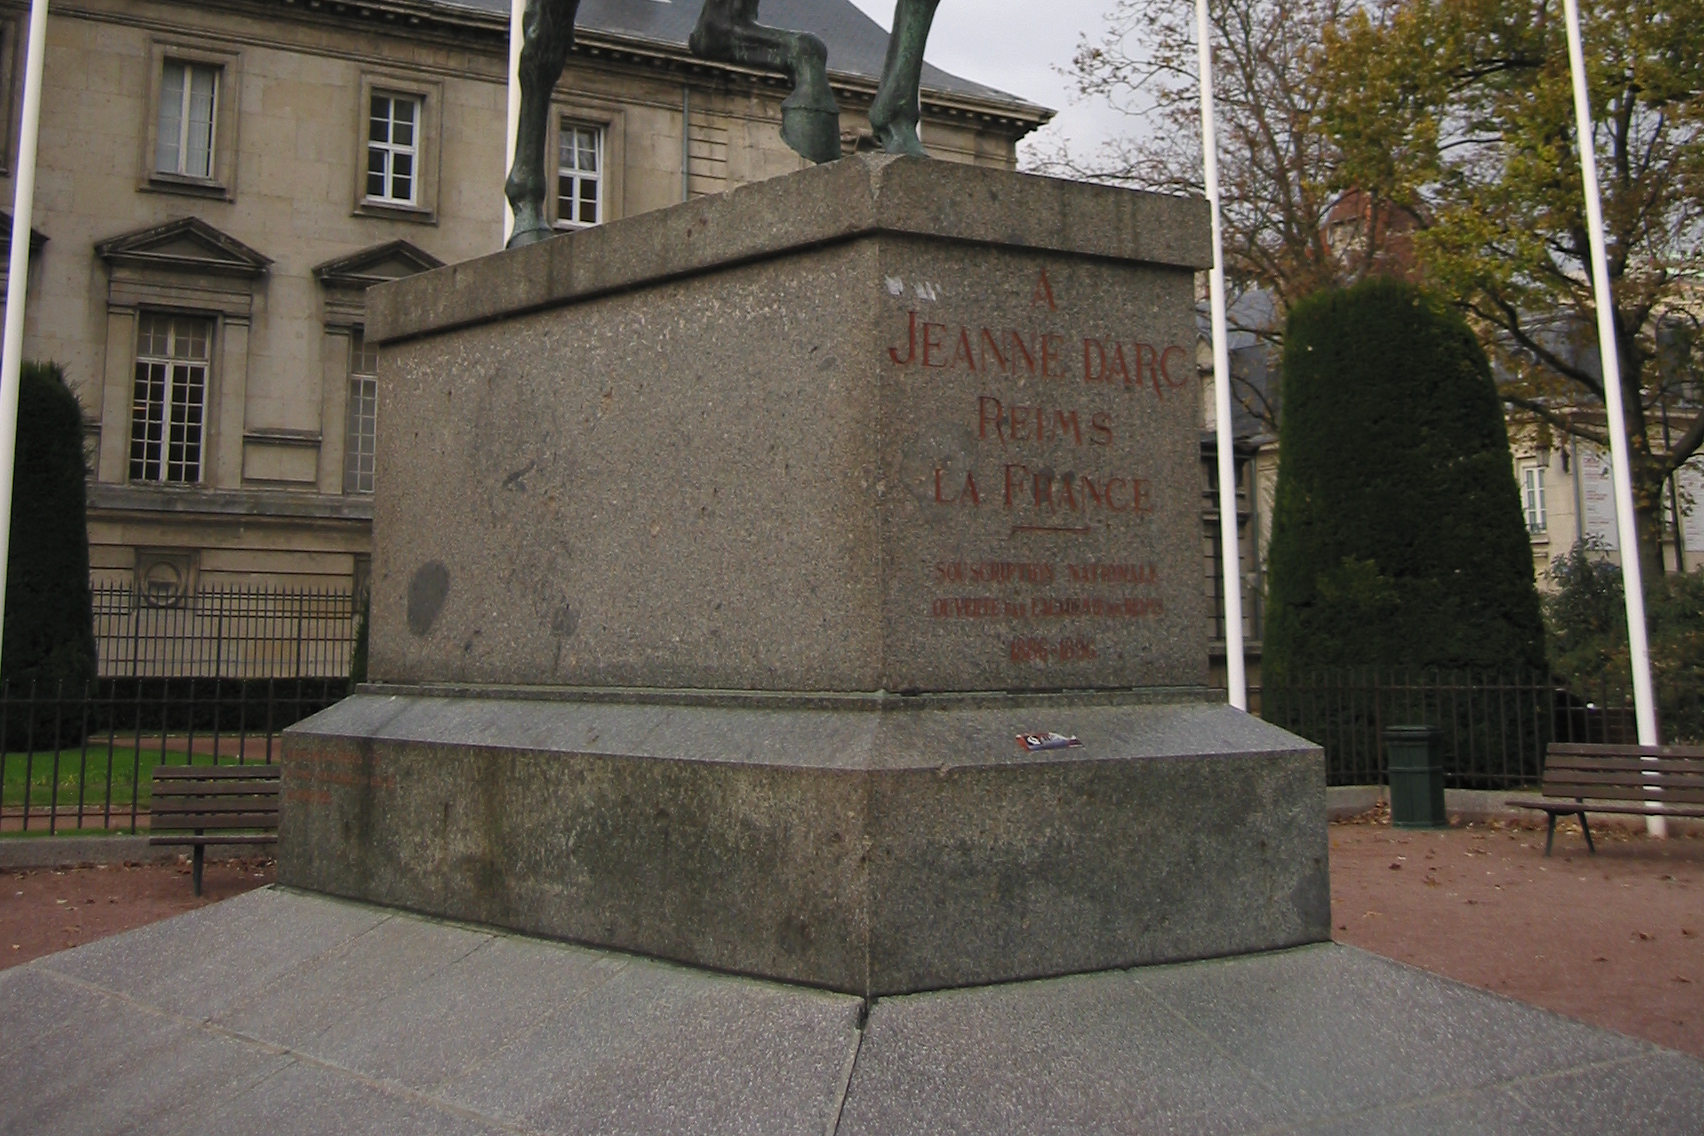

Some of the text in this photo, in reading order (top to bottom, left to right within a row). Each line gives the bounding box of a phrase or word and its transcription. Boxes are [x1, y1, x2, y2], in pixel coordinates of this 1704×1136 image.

[1030, 266, 1057, 311] A
[888, 310, 1187, 401] JEANNE D'ARC
[978, 396, 1113, 451] REIMS
[934, 464, 1153, 514] LA FRANCE
[1067, 563, 1160, 585] NATIONALE
